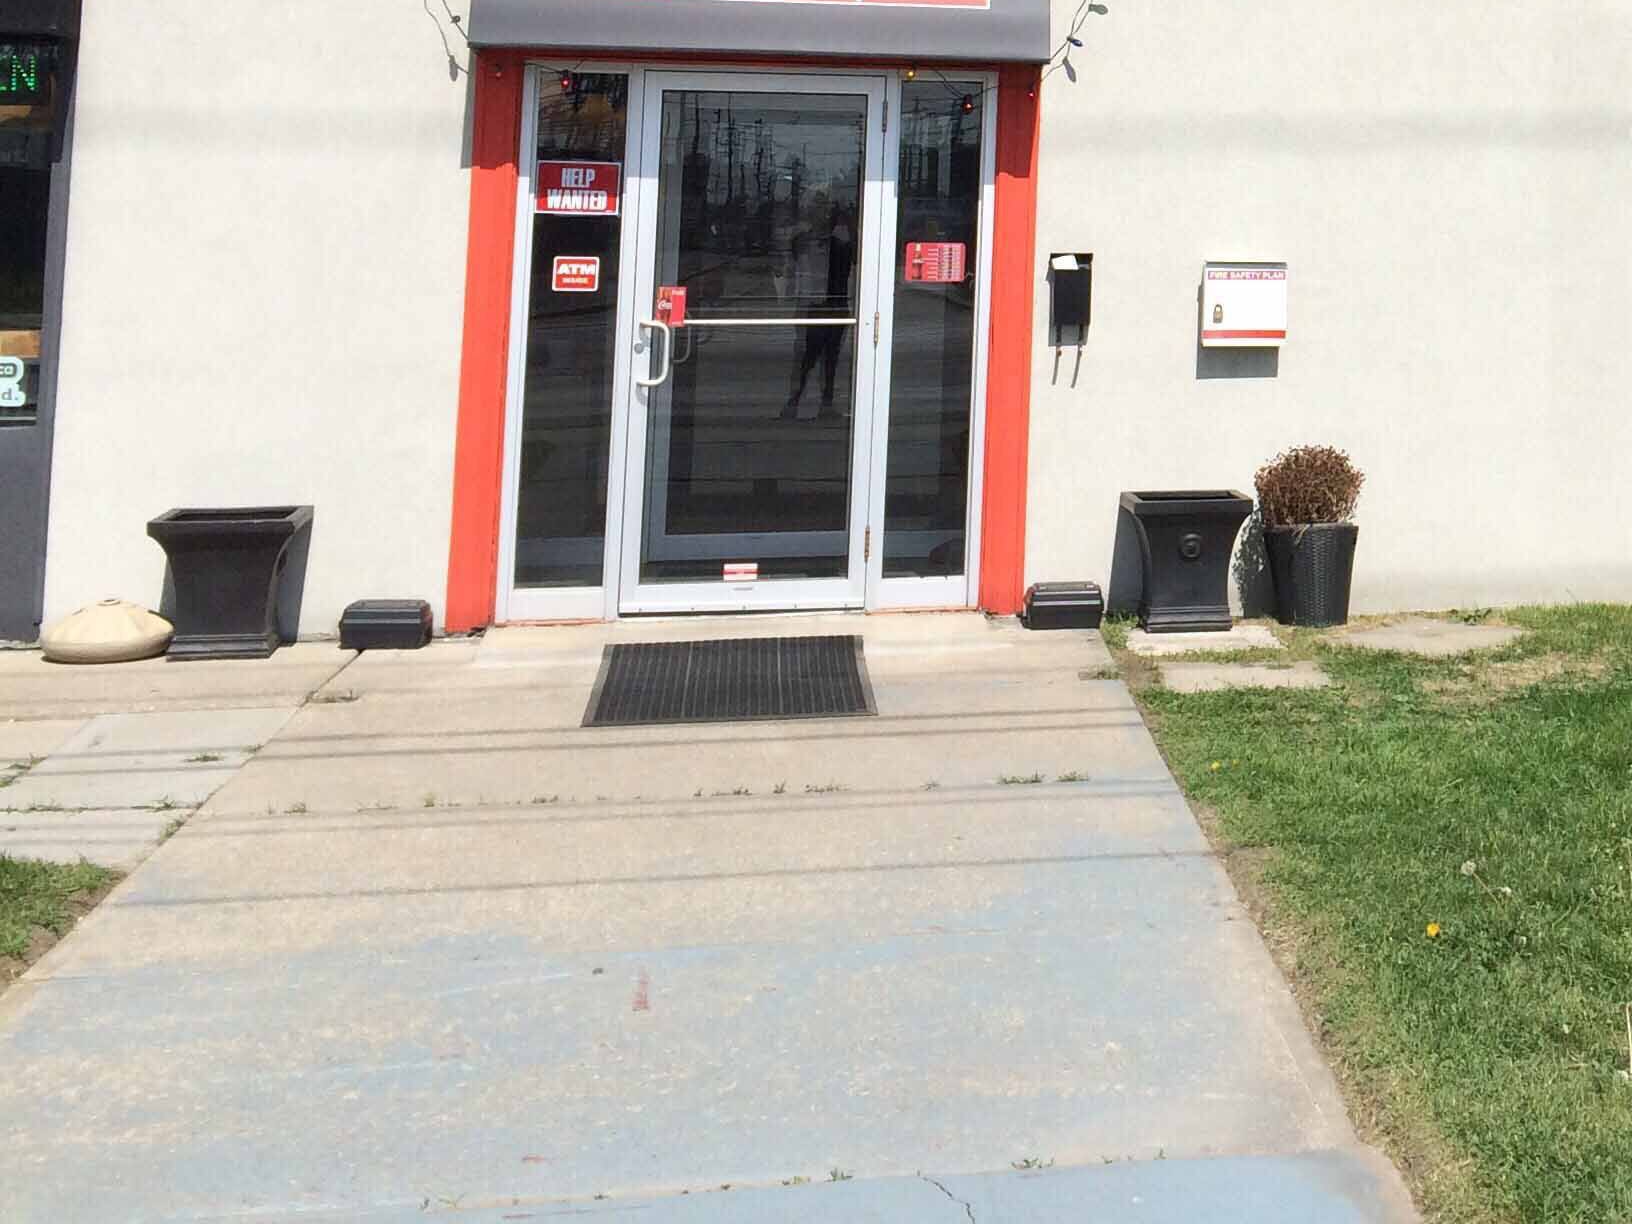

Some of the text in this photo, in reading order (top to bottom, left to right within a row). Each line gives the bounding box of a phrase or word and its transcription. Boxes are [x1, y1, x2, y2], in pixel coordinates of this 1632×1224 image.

[562, 168, 595, 188] HELP
[547, 188, 607, 210] WANTED
[557, 263, 597, 276] ATM
[1229, 271, 1262, 280] SAFETY
[1263, 271, 1285, 280] PLAN
